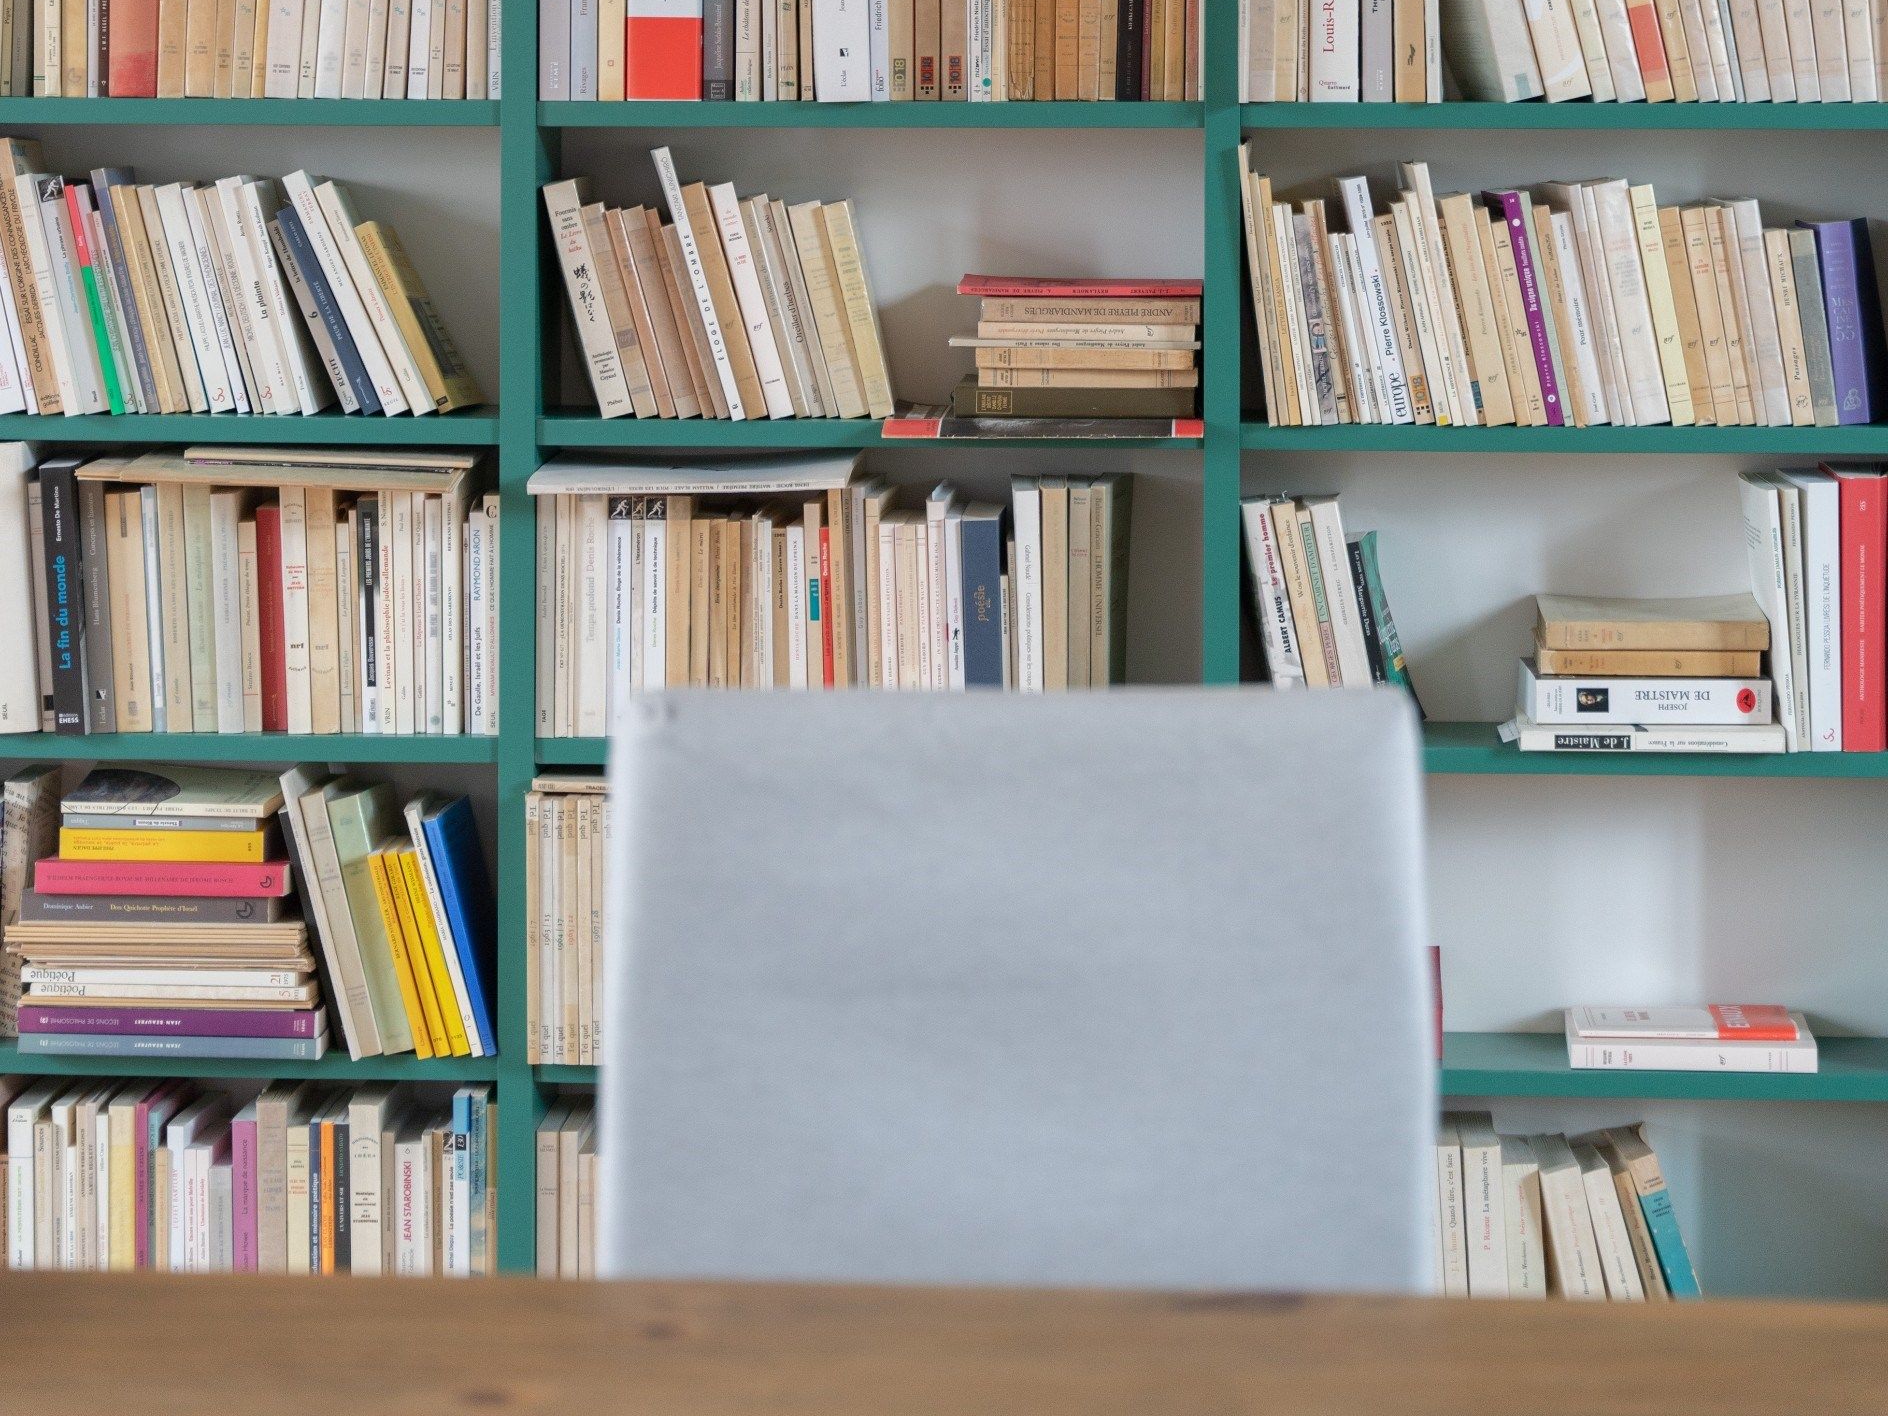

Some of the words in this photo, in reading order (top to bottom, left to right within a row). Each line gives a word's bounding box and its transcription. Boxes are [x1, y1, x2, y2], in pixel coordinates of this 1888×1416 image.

[28, 283, 40, 310] DERRIDA
[252, 280, 268, 307] plainte
[1370, 274, 1389, 326] Klossowski
[258, 309, 269, 319] La
[1024, 307, 1092, 315] MANDIARGUES
[1094, 307, 1106, 316] DE
[1108, 308, 1139, 316] PIEYRE
[1141, 308, 1173, 318] ANDRÉ
[1572, 297, 1583, 327] mémoire
[34, 312, 46, 339] JACQUES
[1380, 328, 1395, 356] Pierre
[1577, 329, 1586, 345] Pour
[28, 334, 43, 372] CONDILLAC
[1389, 372, 1410, 417] europe
[52, 486, 60, 509] Martino
[54, 510, 61, 518] De
[54, 520, 62, 542] Ernesto
[52, 555, 67, 604] monde
[473, 557, 481, 601] RAYMOND
[55, 608, 69, 626] du
[1274, 596, 1286, 623] CAMUS
[56, 631, 70, 649] fin
[1280, 626, 1293, 653] ALBERT
[58, 653, 71, 669] La
[1635, 691, 1690, 700] MAISTRE
[1694, 691, 1710, 700] DE
[43, 902, 73, 911] Dominique
[30, 970, 76, 982] Poétique
[1480, 1150, 1488, 1165] vive
[241, 1170, 248, 1180] de
[1481, 1167, 1491, 1201] métaphore
[403, 1161, 412, 1217] STAROBINSKI
[1482, 1203, 1490, 1212] La
[403, 1219, 412, 1242] JEAN
